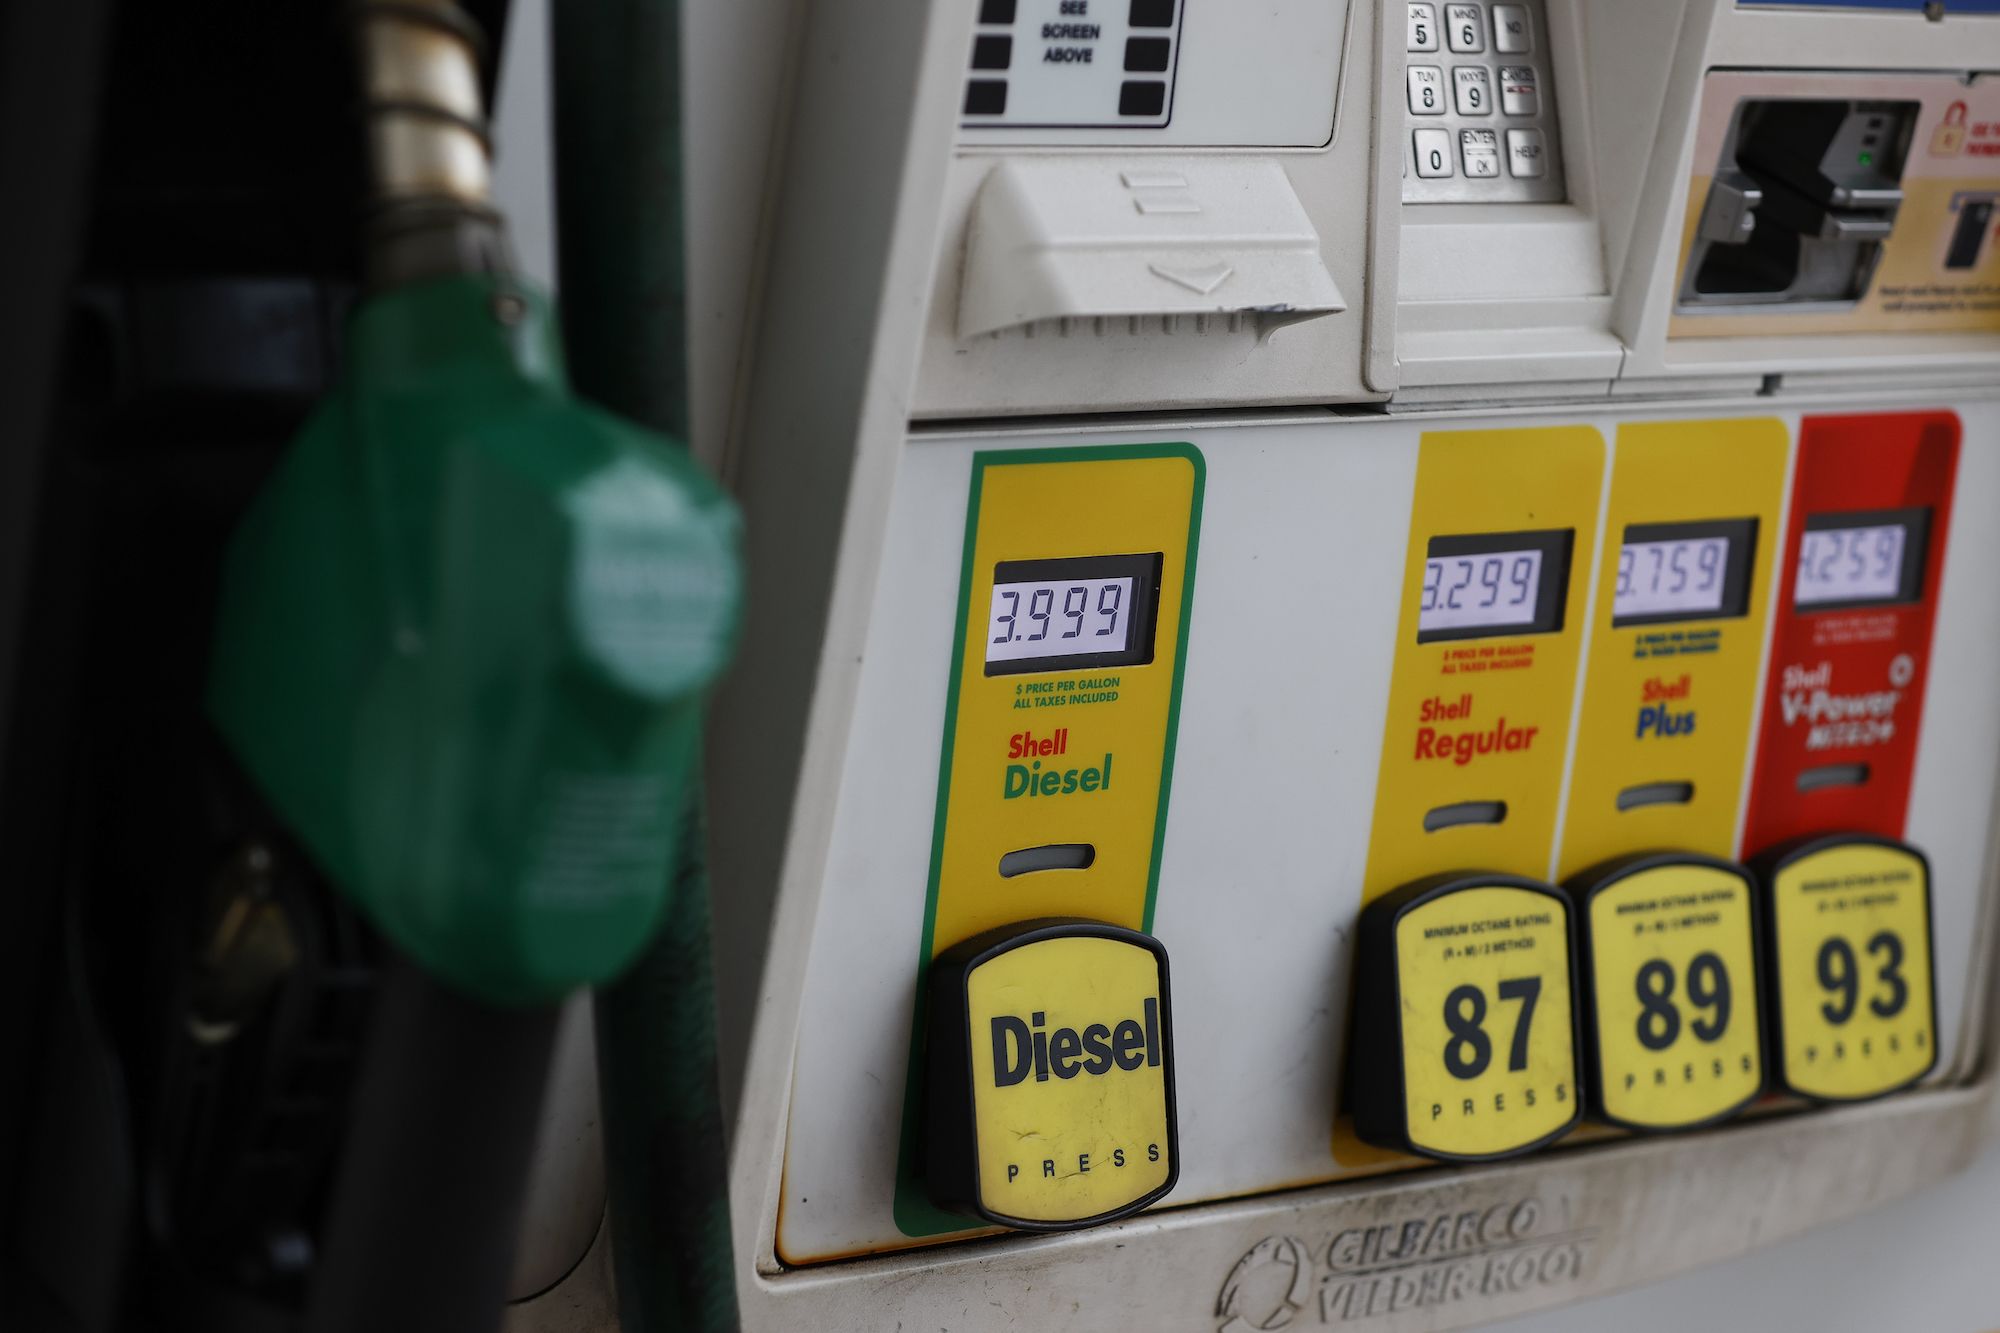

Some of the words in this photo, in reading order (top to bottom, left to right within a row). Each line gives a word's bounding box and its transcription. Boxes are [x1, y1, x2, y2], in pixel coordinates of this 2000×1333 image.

[1060, 0, 1087, 15] SEE
[1042, 24, 1101, 40] SCREEN
[1415, 24, 1427, 45] 5
[1463, 25, 1474, 45] 6
[1043, 47, 1093, 63] ABOVE
[1423, 87, 1435, 108] 8
[1469, 87, 1480, 108] 9
[1430, 149, 1442, 171] 0
[1421, 556, 1534, 611] 3.299
[993, 584, 1122, 644] 3.999
[1014, 698, 1031, 709] ALL
[1035, 695, 1066, 708] TAXES
[1069, 691, 1119, 705] INCLUDED
[1026, 682, 1054, 694] PRICE
[1057, 680, 1075, 691] PER
[1078, 677, 1120, 690] GALLON
[1642, 674, 1691, 702] Shell
[1420, 694, 1472, 722] Shell
[1636, 702, 1696, 739] Plus
[1008, 728, 1068, 759] Shell
[1414, 717, 1538, 766] Regular
[1004, 753, 1112, 800] Diesel
[1816, 929, 1910, 1028] 93
[1635, 950, 1732, 1052] 89
[991, 997, 1161, 1088] Diesel
[1443, 975, 1542, 1081] 87
[1432, 1083, 1568, 1121] PRESS
[1007, 1143, 1160, 1183] PRESS
[1327, 1197, 1537, 1272] GILBARCO
